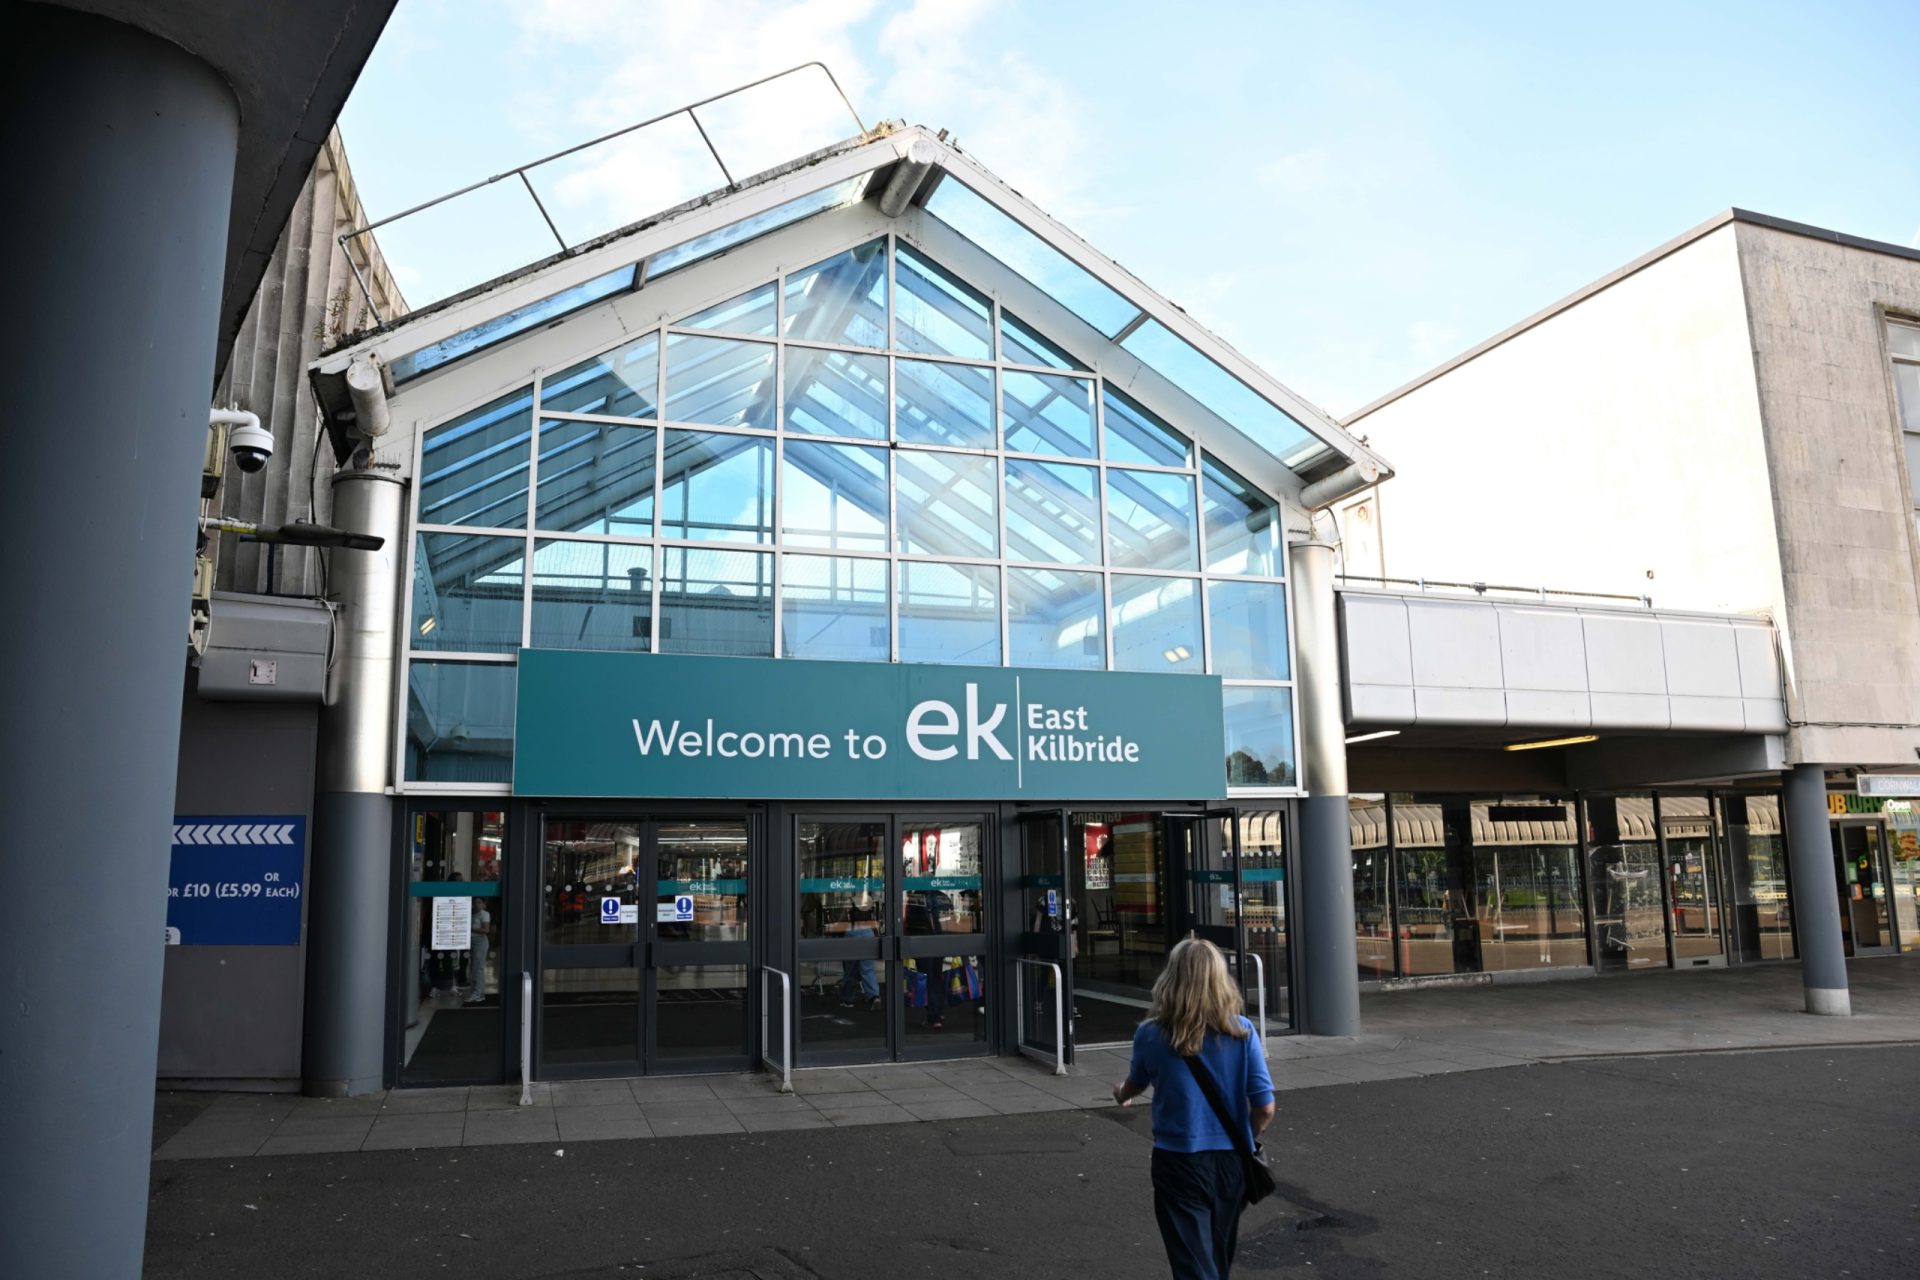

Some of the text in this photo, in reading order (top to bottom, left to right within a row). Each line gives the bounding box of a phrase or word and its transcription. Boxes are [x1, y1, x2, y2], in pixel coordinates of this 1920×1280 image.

[905, 682, 1014, 761] ek
[1027, 703, 1089, 731] East
[631, 718, 887, 760] Welcome to
[1028, 734, 1140, 763] Kilbride
[1827, 793, 1887, 814] UBWAY
[167, 881, 300, 899] OR £10 (£5.99 EACH)
[264, 872, 280, 882] OR
